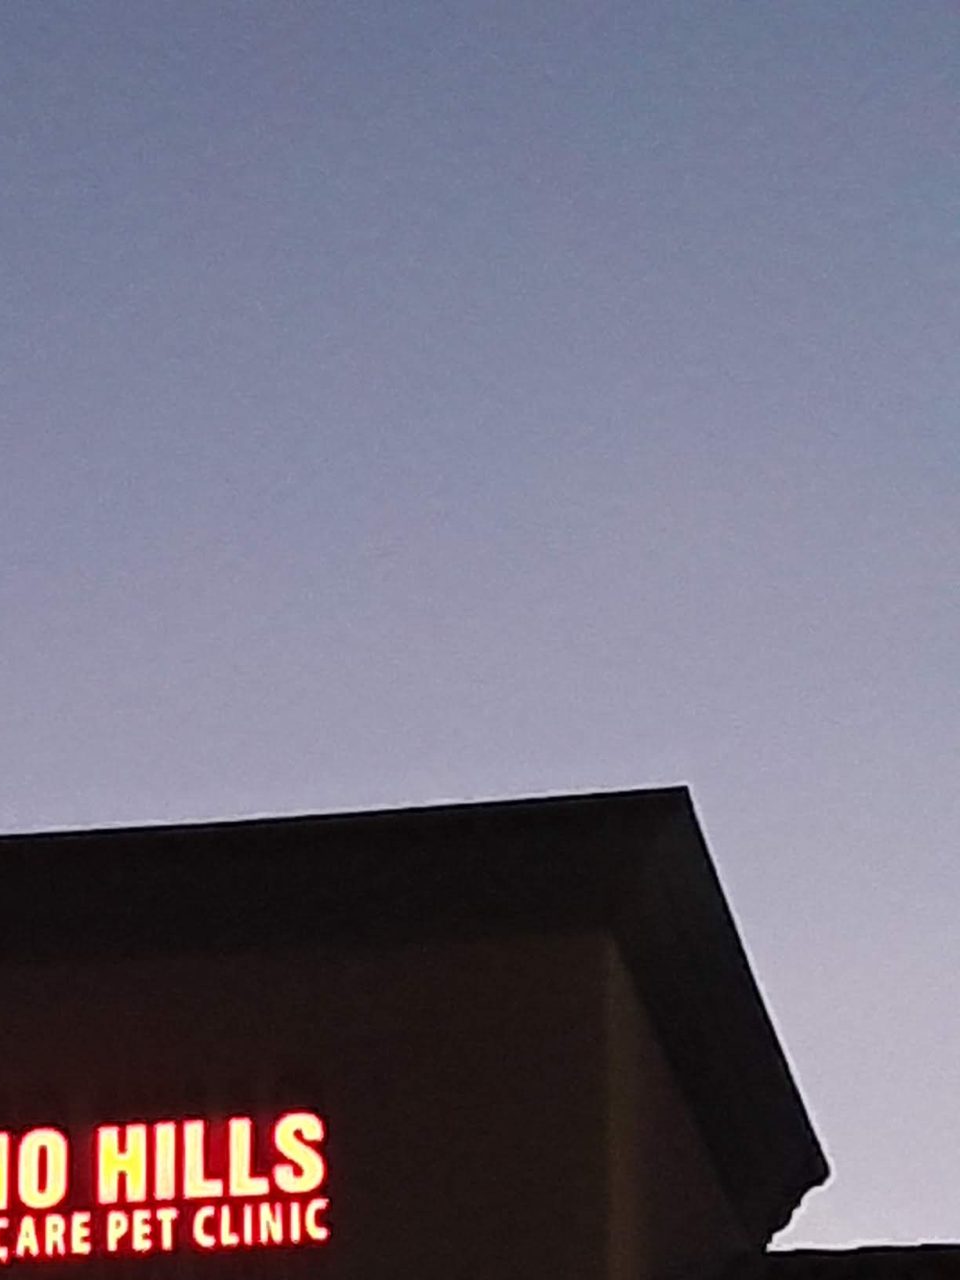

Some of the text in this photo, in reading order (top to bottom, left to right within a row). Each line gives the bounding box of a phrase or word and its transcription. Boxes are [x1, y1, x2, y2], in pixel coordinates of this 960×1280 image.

[97, 1111, 325, 1205] HILLS
[106, 1206, 179, 1254] PET
[191, 1197, 330, 1249] CLINIC
